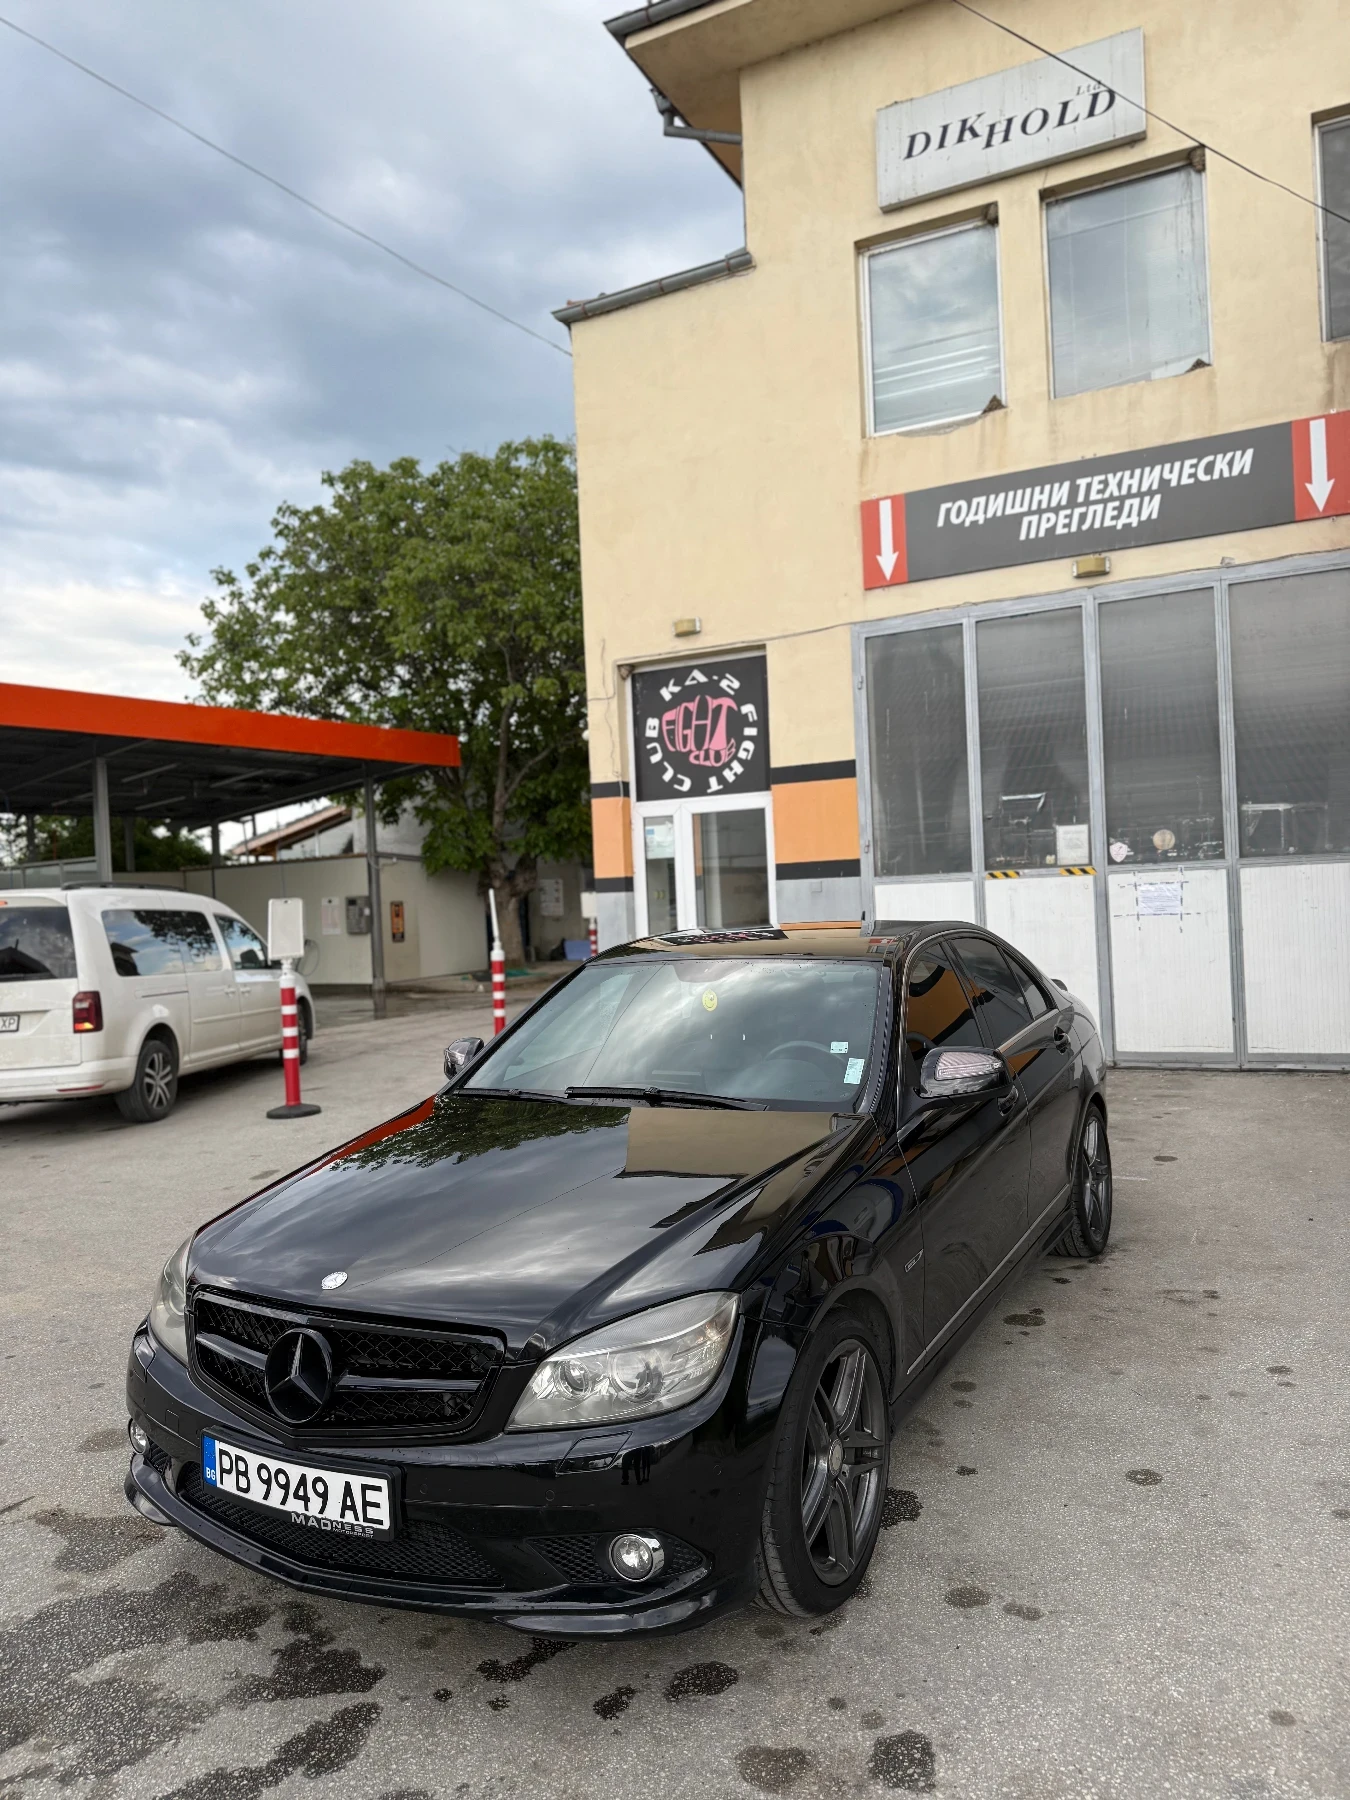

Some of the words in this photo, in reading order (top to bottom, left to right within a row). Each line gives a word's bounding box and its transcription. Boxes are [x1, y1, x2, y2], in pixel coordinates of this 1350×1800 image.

[1076, 80, 1102, 96] Ltd
[903, 89, 1116, 161] DIKHOLD
[937, 481, 1070, 528] ГОДИШНИ
[1076, 448, 1254, 503] ТЕХНИЧЕСКИ
[1019, 494, 1162, 541] ПРЕГЛЕДИ
[662, 695, 738, 752] FIGHT
[706, 703, 758, 793] FIGHT
[645, 717, 692, 792] CLUB
[689, 738, 736, 767] CLUB
[205, 1467, 216, 1481] BG
[218, 1448, 251, 1494] PB
[256, 1463, 329, 1515] 9949
[340, 1480, 384, 1526] AE
[291, 1512, 374, 1535] MADNESS
